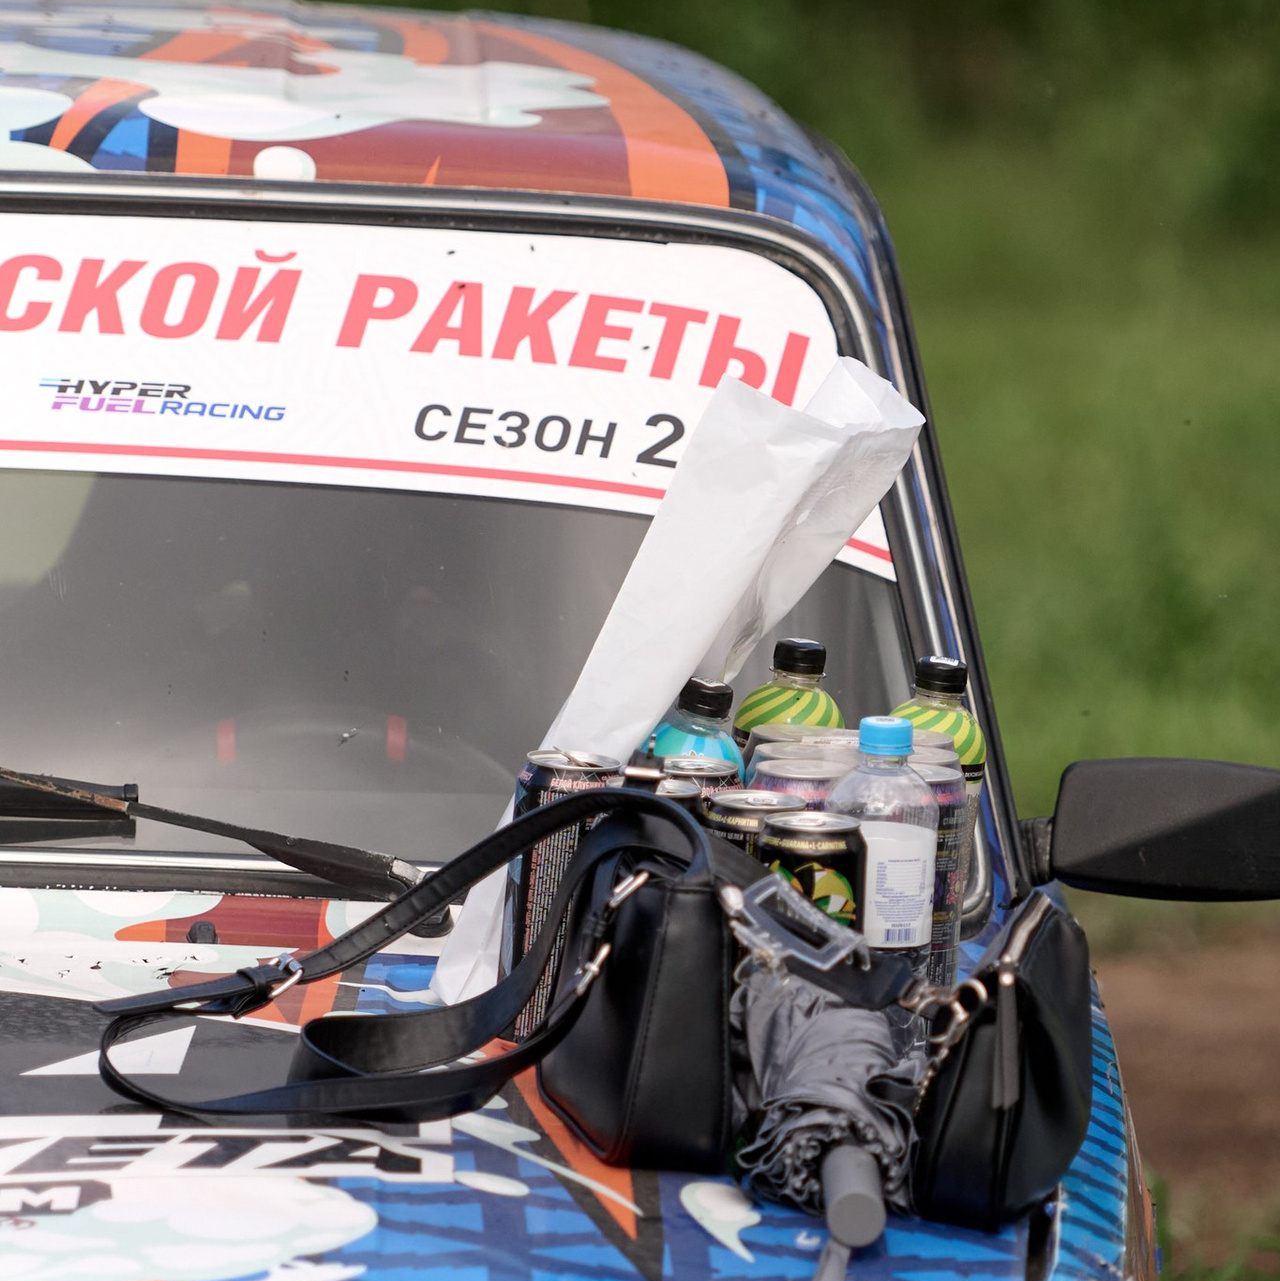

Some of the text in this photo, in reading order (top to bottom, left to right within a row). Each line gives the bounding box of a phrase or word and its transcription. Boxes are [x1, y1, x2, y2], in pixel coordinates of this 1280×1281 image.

[0, 250, 811, 408] СКОЙ РАКЕТЫ
[39, 378, 192, 400] HYPER
[413, 403, 618, 460] СЕЗОН
